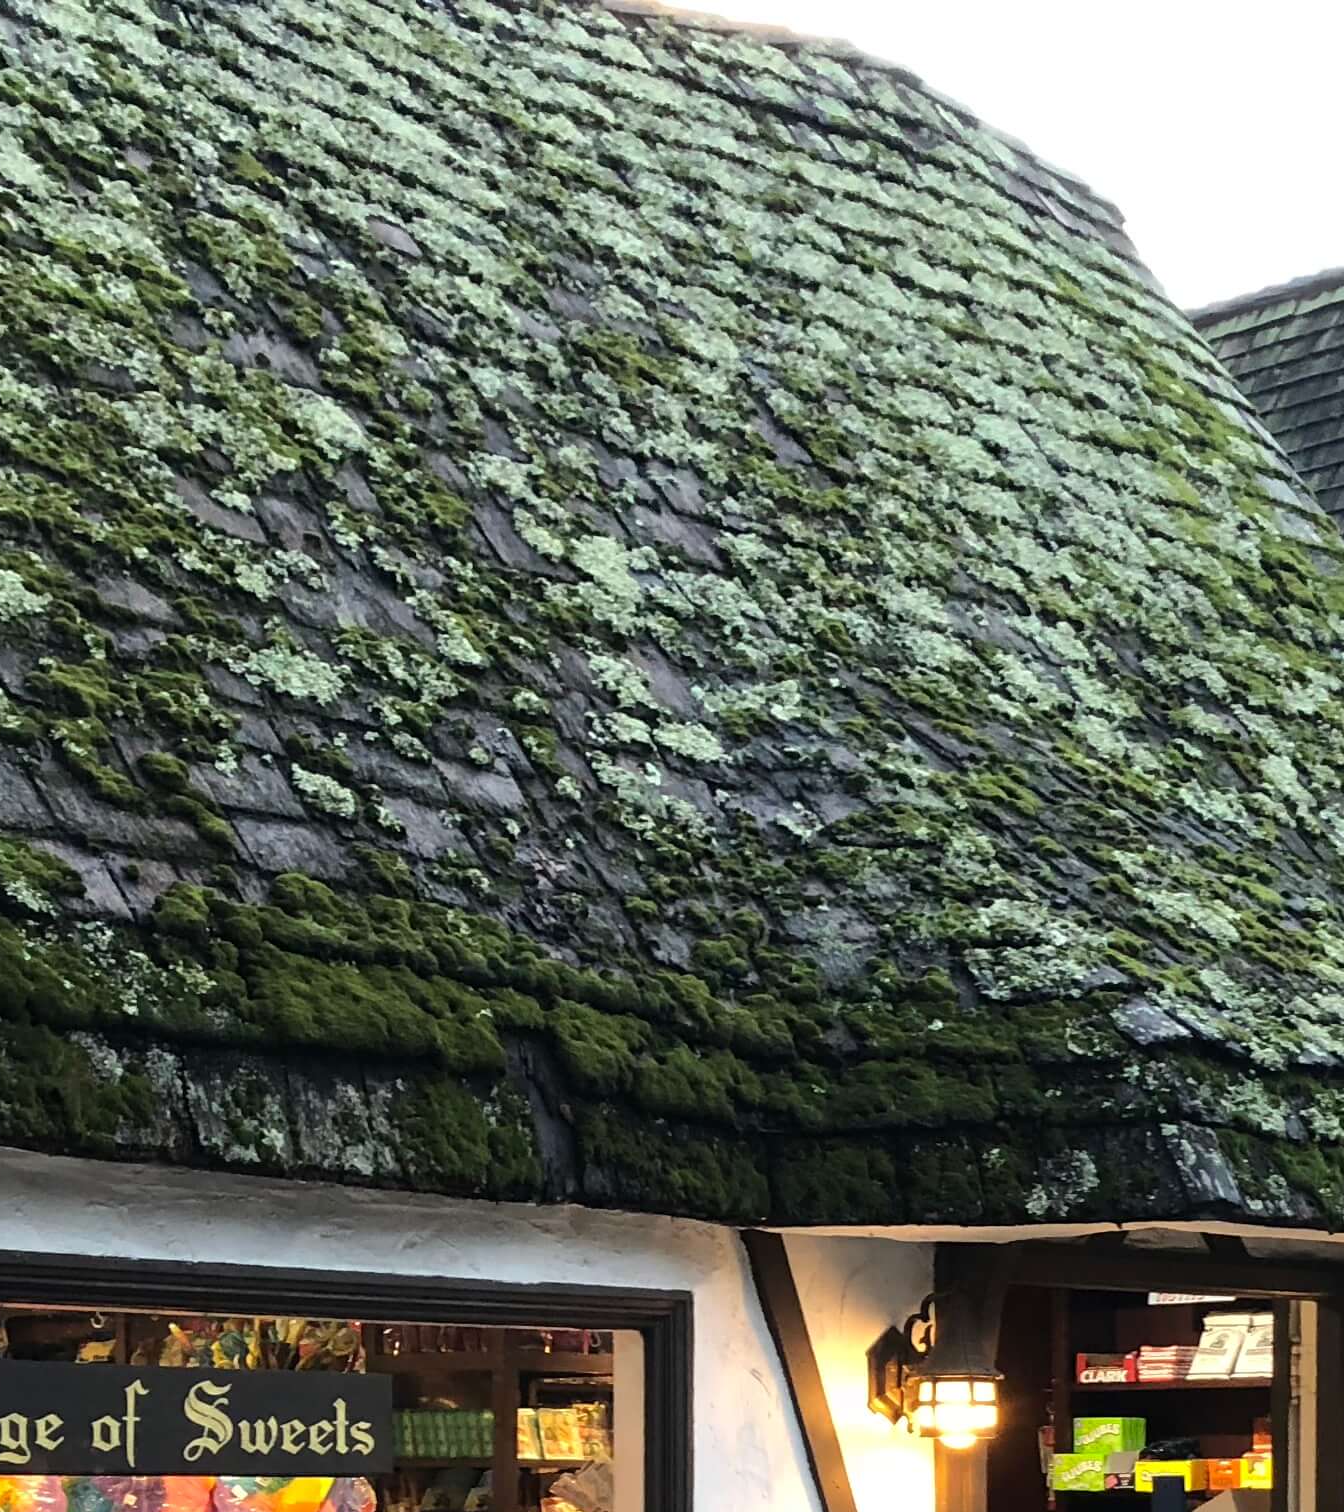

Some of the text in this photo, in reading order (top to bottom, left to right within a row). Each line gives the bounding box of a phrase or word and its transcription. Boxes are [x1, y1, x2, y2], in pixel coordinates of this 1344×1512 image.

[1079, 1369, 1129, 1384] CLARK
[90, 1379, 150, 1468] of
[183, 1379, 376, 1463] Sweets
